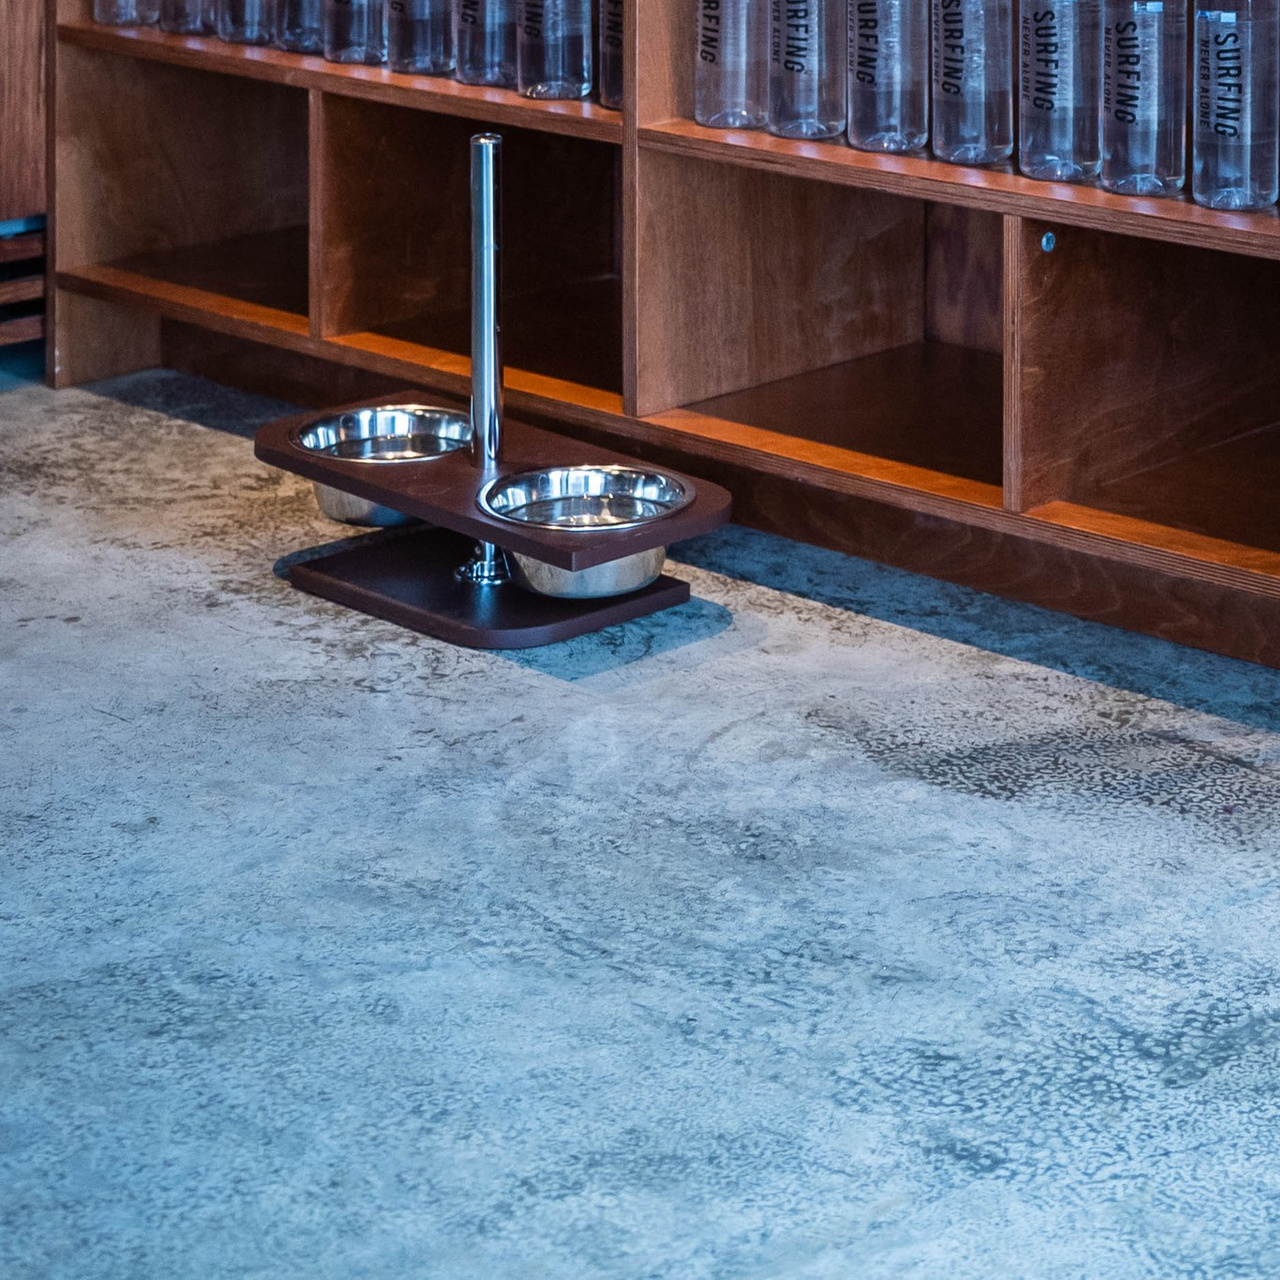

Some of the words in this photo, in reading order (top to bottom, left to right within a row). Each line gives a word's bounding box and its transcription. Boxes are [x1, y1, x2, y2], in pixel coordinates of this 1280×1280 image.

[1021, 16, 1030, 57] NEVER
[1104, 26, 1113, 68] NEVER
[1033, 10, 1059, 112] SURFING
[1114, 21, 1141, 125] SURFING
[1199, 39, 1209, 79] NEVER
[1021, 62, 1030, 100] ALONE
[1103, 74, 1112, 113] ALONE
[1213, 32, 1242, 138] SURFING
[1199, 88, 1209, 128] ALONE
